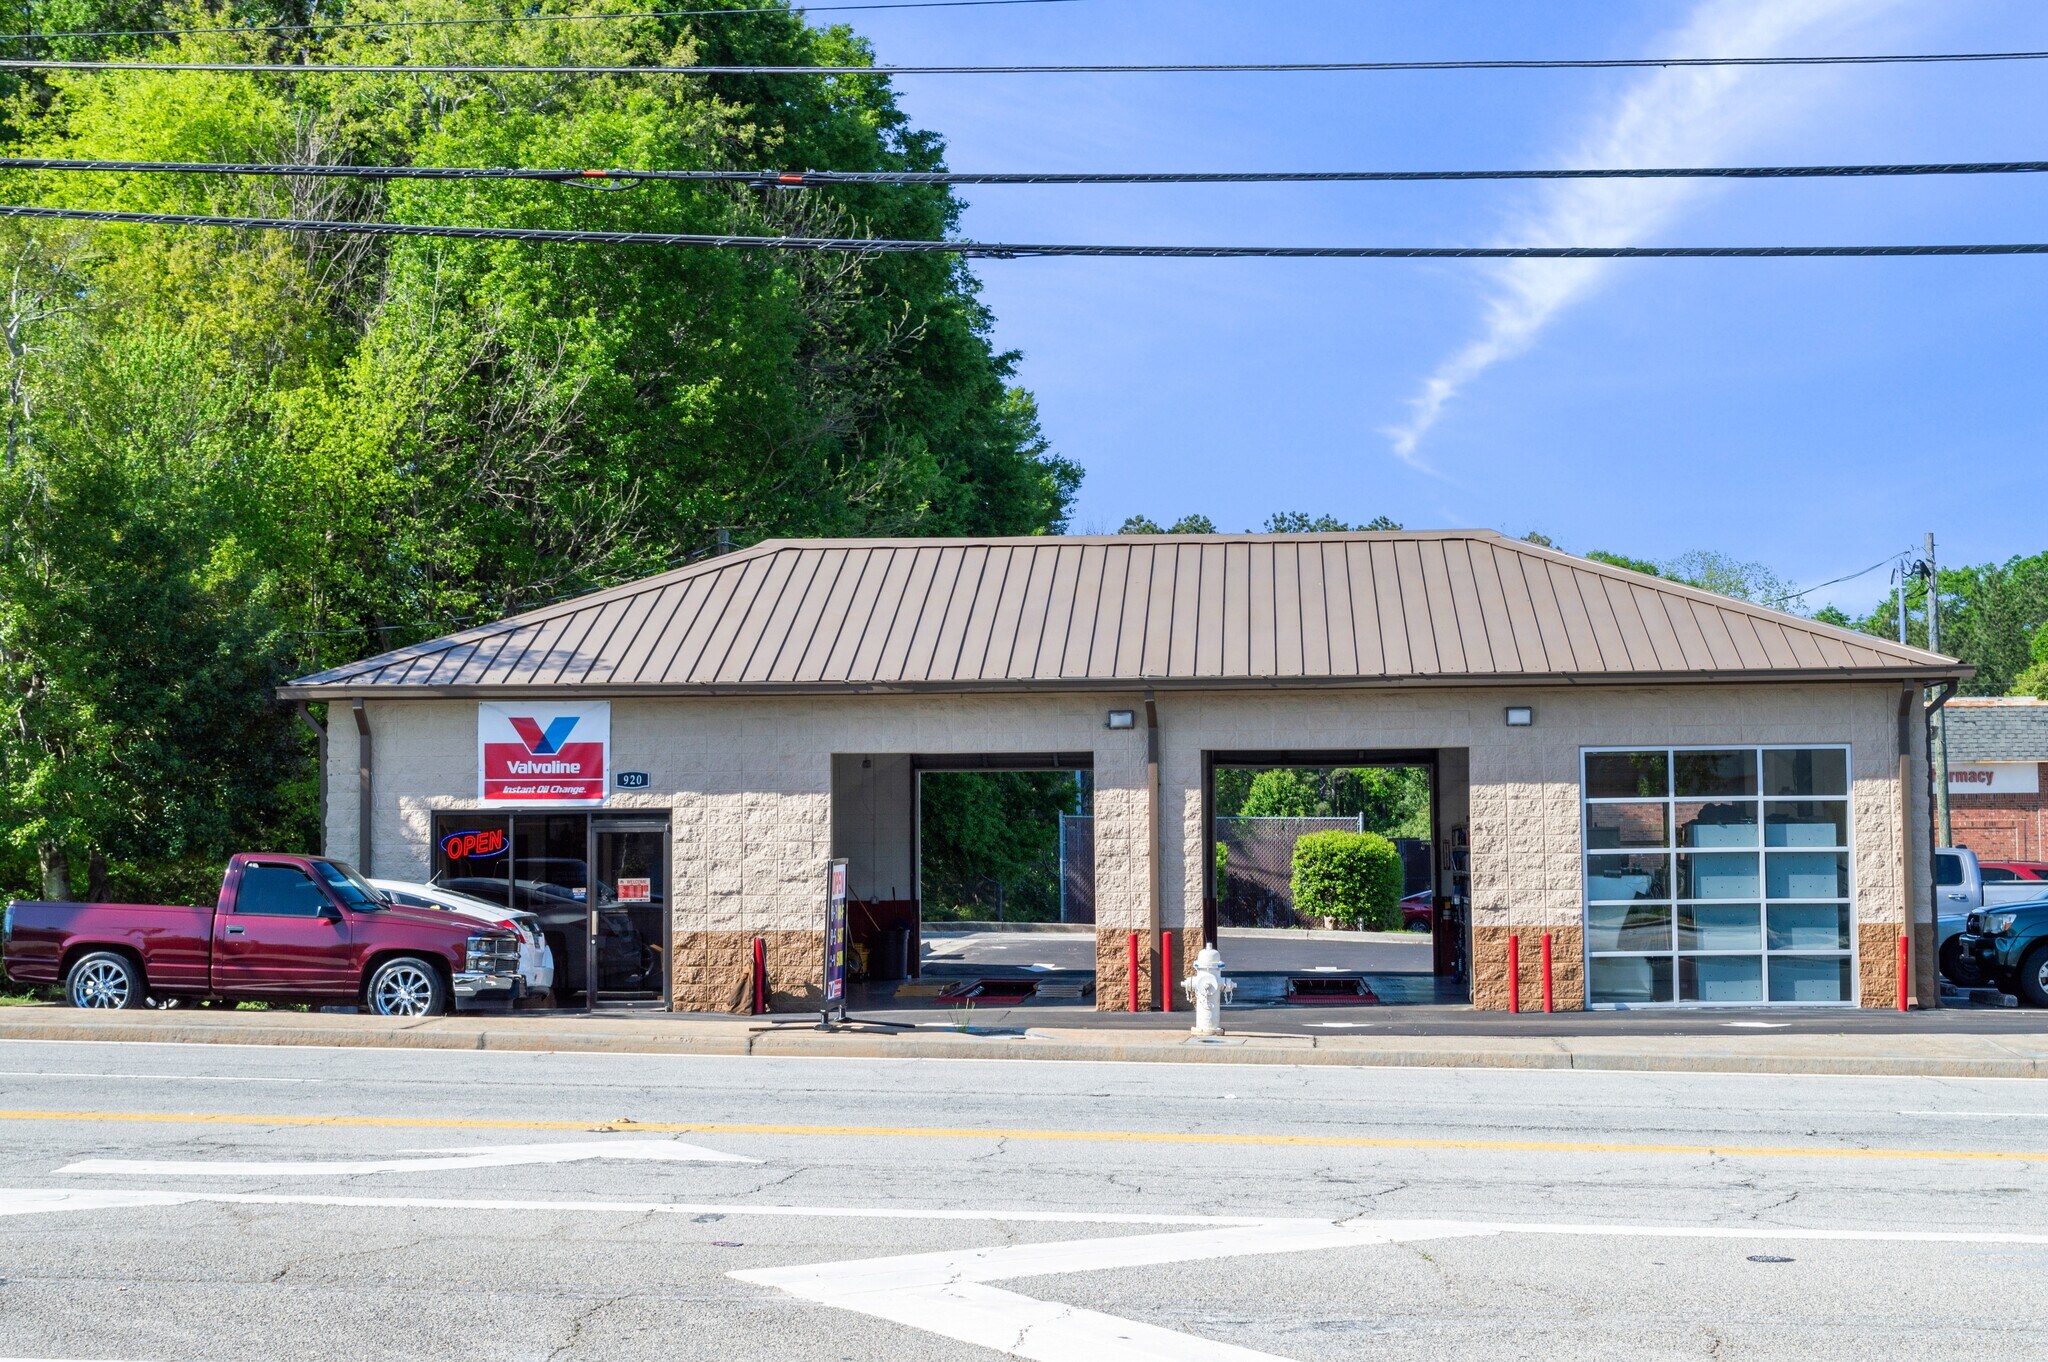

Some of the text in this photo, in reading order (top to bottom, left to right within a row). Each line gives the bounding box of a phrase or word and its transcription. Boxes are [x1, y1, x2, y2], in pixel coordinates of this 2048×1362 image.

[506, 760, 581, 774] Valvoline
[623, 775, 642, 785] 920
[1932, 768, 1994, 786] rmacy
[502, 785, 587, 795] Instant Oil Change.
[447, 829, 503, 860] OPEN
[832, 871, 844, 896] OPEN
